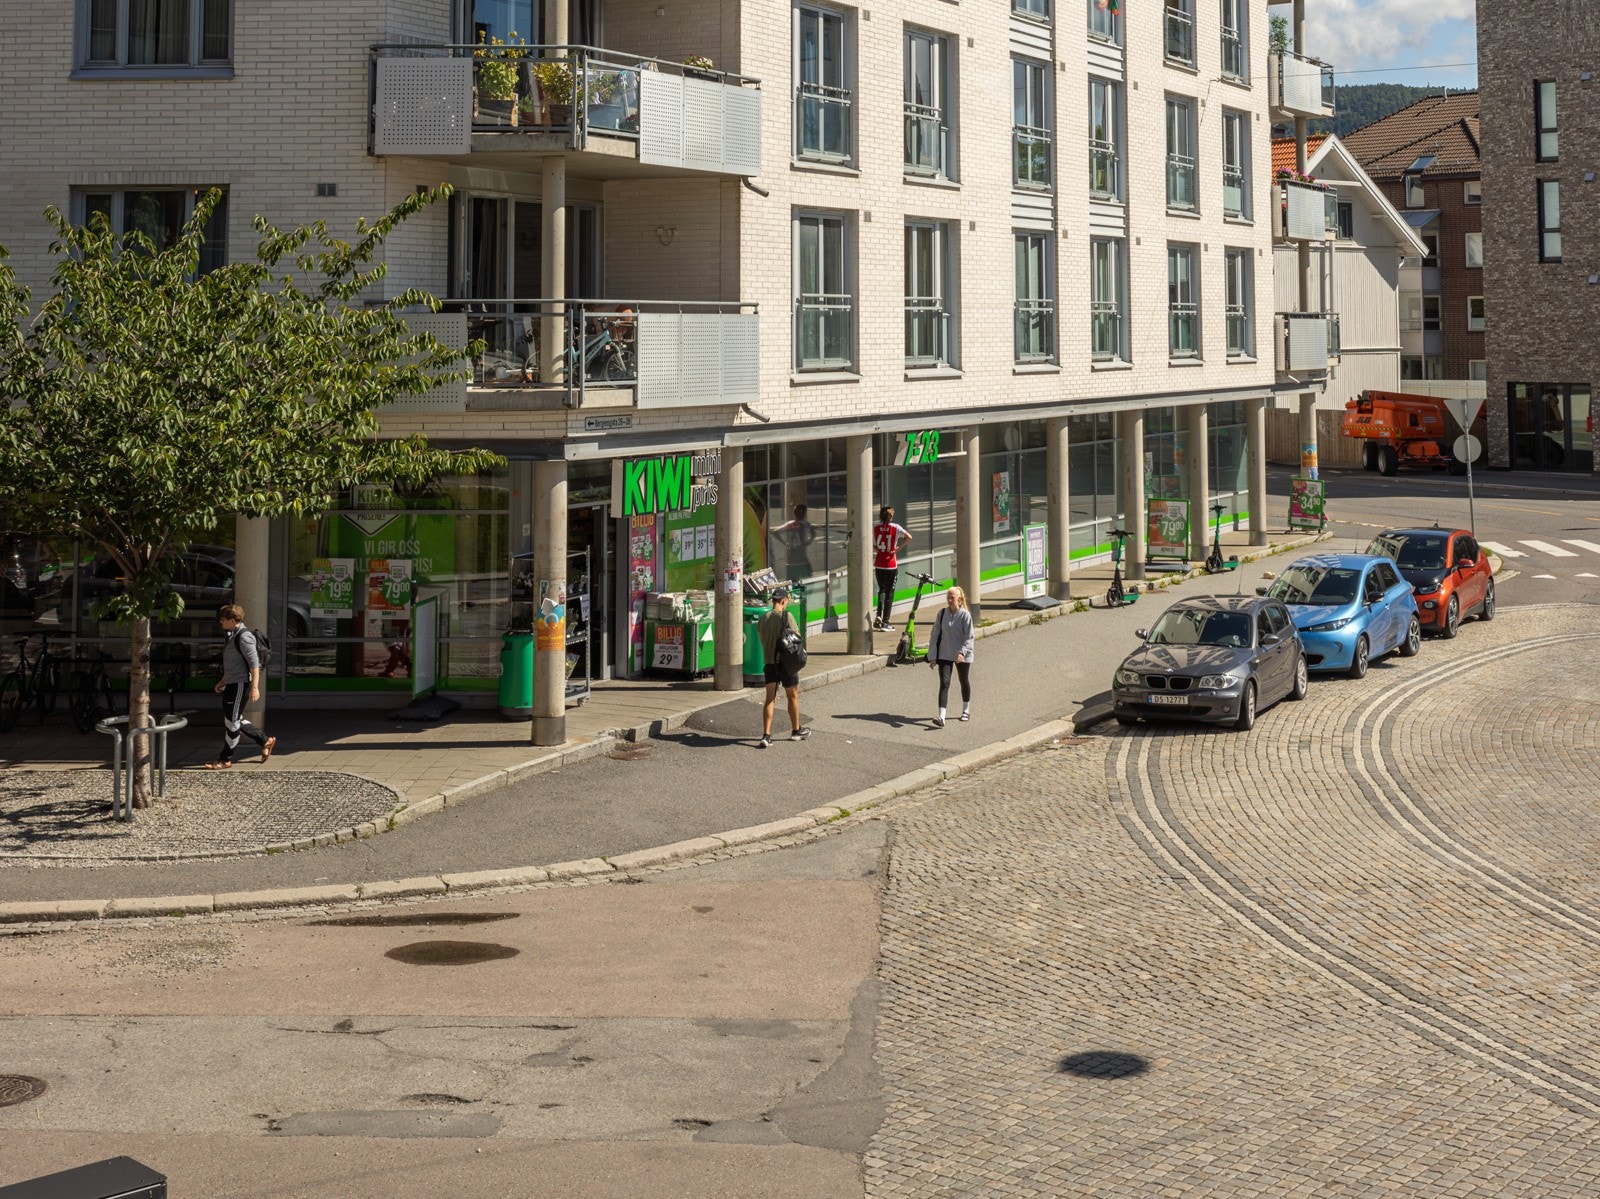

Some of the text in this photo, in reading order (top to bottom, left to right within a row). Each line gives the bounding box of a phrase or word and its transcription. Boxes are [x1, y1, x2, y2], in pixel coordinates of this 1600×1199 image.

[691, 448, 721, 476] mini
[903, 430, 940, 466] 7-23
[623, 455, 691, 515] KIWI
[691, 478, 718, 512] pris
[364, 540, 421, 555] VI GIR OSS
[877, 534, 892, 552] 41
[412, 558, 433, 572] RIS!
